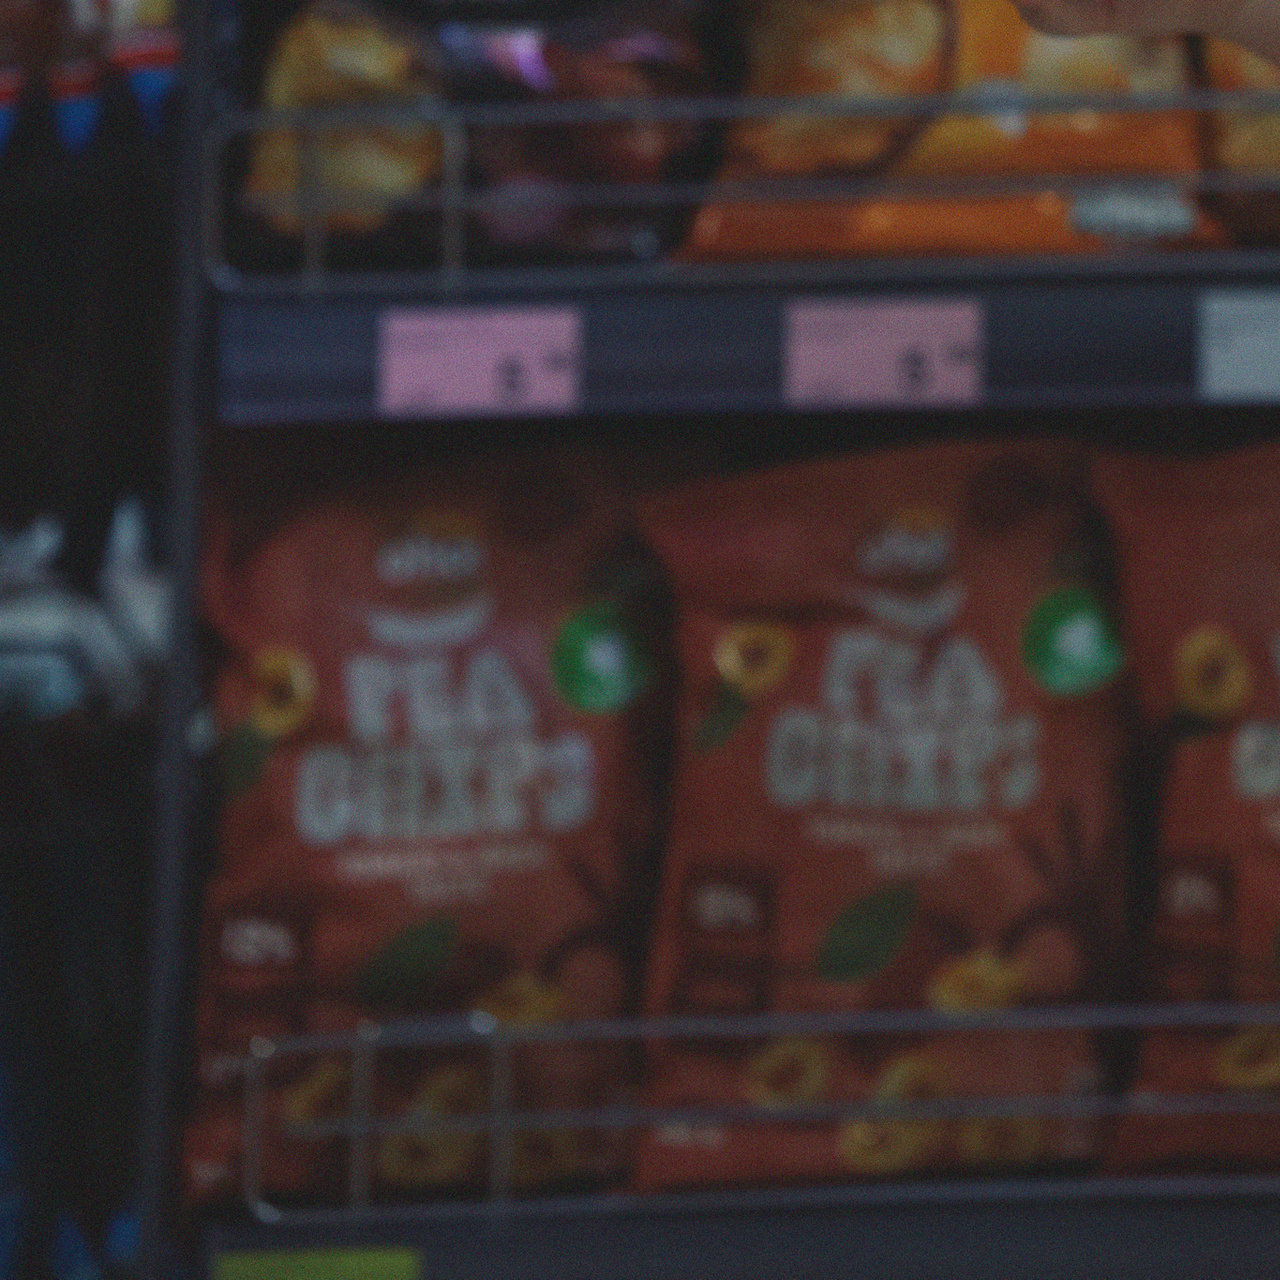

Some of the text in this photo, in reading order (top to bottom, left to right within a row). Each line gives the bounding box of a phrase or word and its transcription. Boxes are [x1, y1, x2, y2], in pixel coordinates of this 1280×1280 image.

[349, 649, 535, 741] PEA
[824, 630, 1004, 724] PEA
[297, 736, 593, 844] CHIPS
[766, 707, 1043, 814] CHIPS
